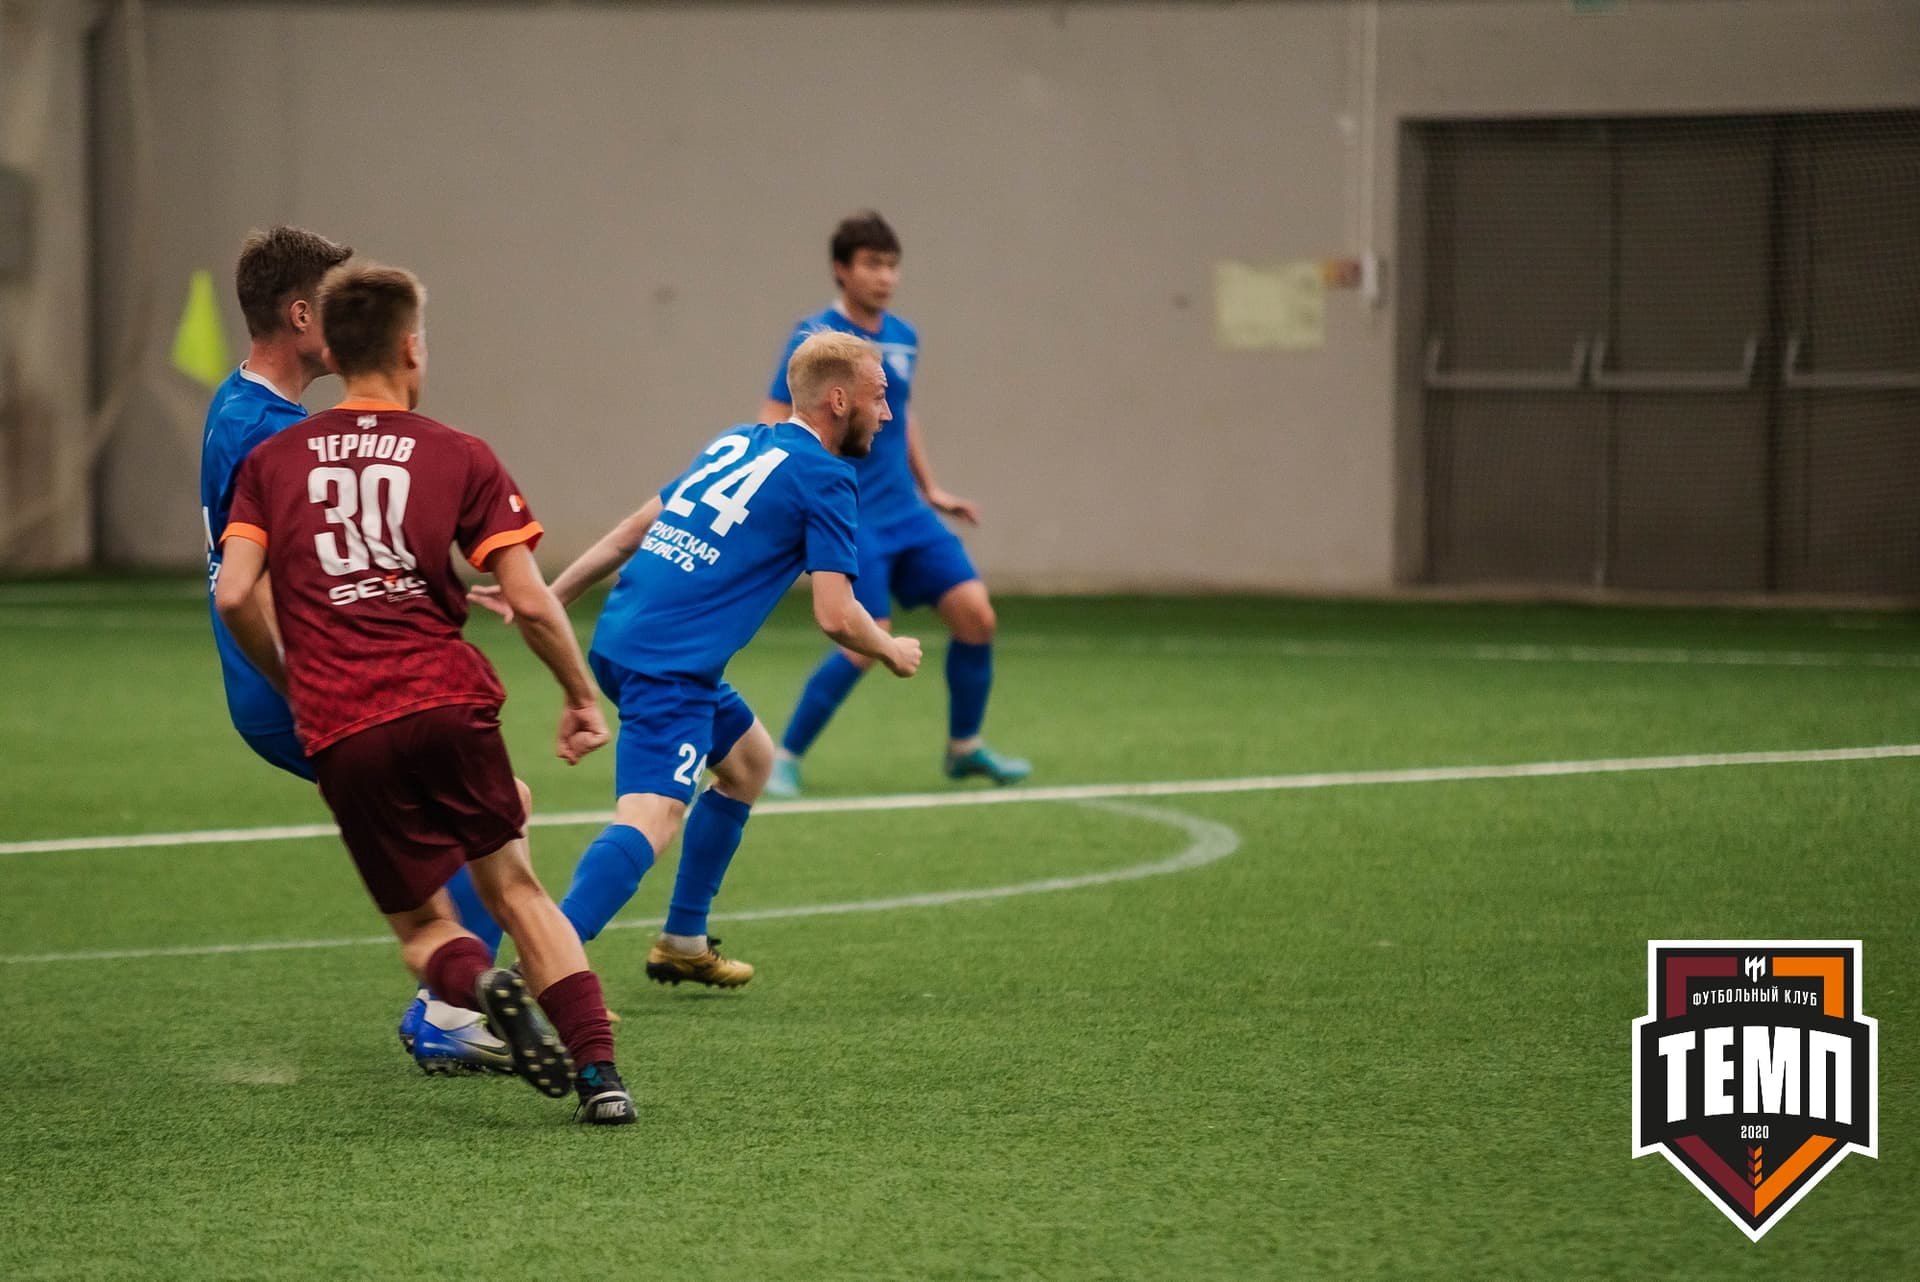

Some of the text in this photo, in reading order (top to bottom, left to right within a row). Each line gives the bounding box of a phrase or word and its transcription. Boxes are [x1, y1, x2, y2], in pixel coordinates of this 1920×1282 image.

[308, 434, 416, 462] ЧЕРНОВ
[670, 434, 790, 537] 24
[308, 464, 417, 576] 30
[648, 520, 721, 566] РКУТСКАЯ
[595, 1100, 626, 1119] NIKE
